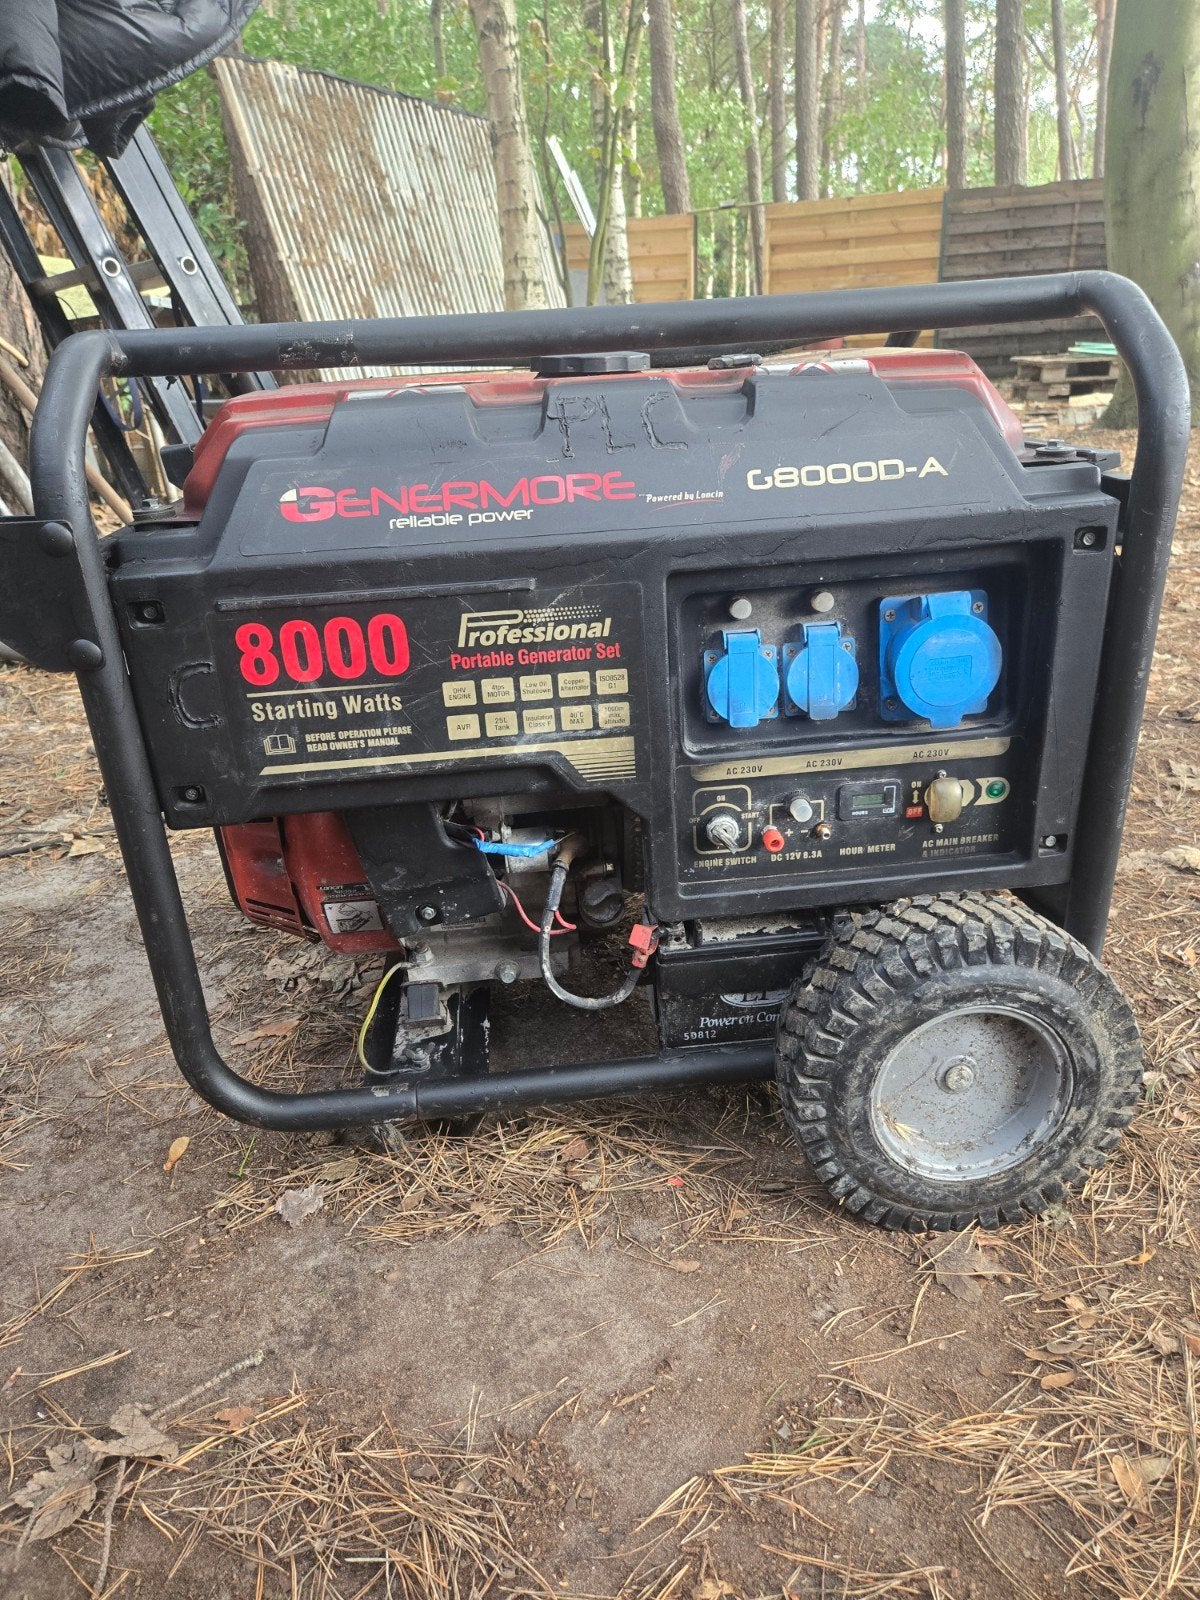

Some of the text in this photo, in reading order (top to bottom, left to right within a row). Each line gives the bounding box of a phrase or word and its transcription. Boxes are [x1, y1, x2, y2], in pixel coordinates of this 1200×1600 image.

[746, 456, 949, 490] G8000D-A
[280, 470, 636, 523] GENERMORE
[646, 489, 724, 503] Powered by Loncin
[389, 507, 535, 530] reliable power
[457, 609, 612, 648] Professional
[235, 613, 410, 686] 8000
[450, 642, 621, 670] Portable Generator Set
[563, 678, 585, 686] Copper
[448, 693, 472, 701] ENGINE
[487, 690, 510, 698] MOTOR
[251, 693, 403, 722] Starting Watts
[305, 725, 413, 743] BEFORE OPERATION PLEASE
[456, 723, 472, 731] AVR
[307, 737, 400, 753] READ OWNER'S MANUAL
[912, 749, 950, 759] AC 230V
[806, 758, 843, 768] AC 230V
[726, 765, 763, 776] AC 230V
[740, 812, 760, 820] START
[907, 807, 922, 815] OFF
[922, 833, 999, 849] AC MAIN BREAKER
[771, 850, 823, 862] DC 12V 8.3A
[839, 843, 896, 856] HOUR METER
[931, 846, 976, 857] INDICATOR
[694, 855, 757, 869] ENGINE SWITCH
[699, 1016, 738, 1029] Power
[739, 1015, 754, 1026] on
